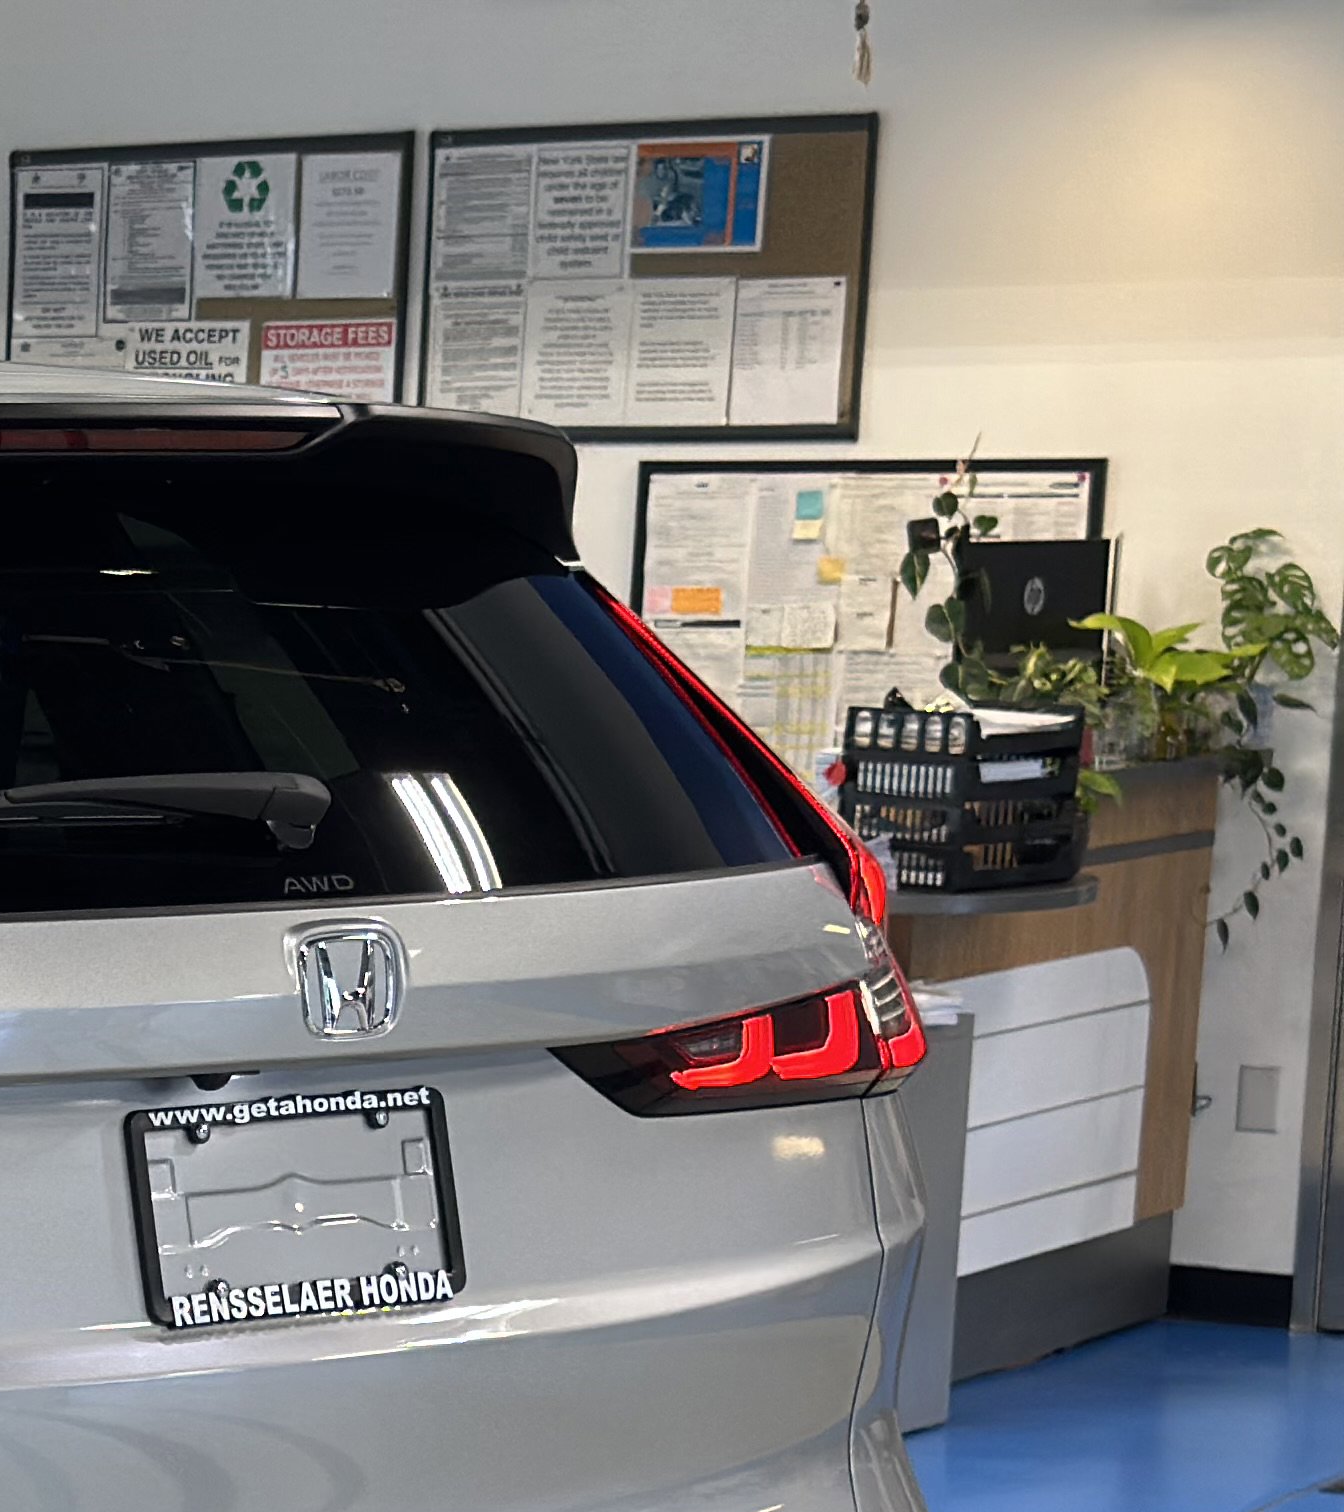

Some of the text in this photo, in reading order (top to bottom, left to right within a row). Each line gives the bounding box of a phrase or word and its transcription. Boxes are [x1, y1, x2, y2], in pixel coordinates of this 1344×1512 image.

[138, 327, 241, 344] WE ACCEPT
[267, 325, 389, 348] STORAGE FEES
[134, 349, 241, 367] USED OIL FOR
[284, 874, 355, 894] AWD
[148, 1086, 431, 1127] www.getahonda.net
[171, 1268, 454, 1328] RENSSELAER HONDA
